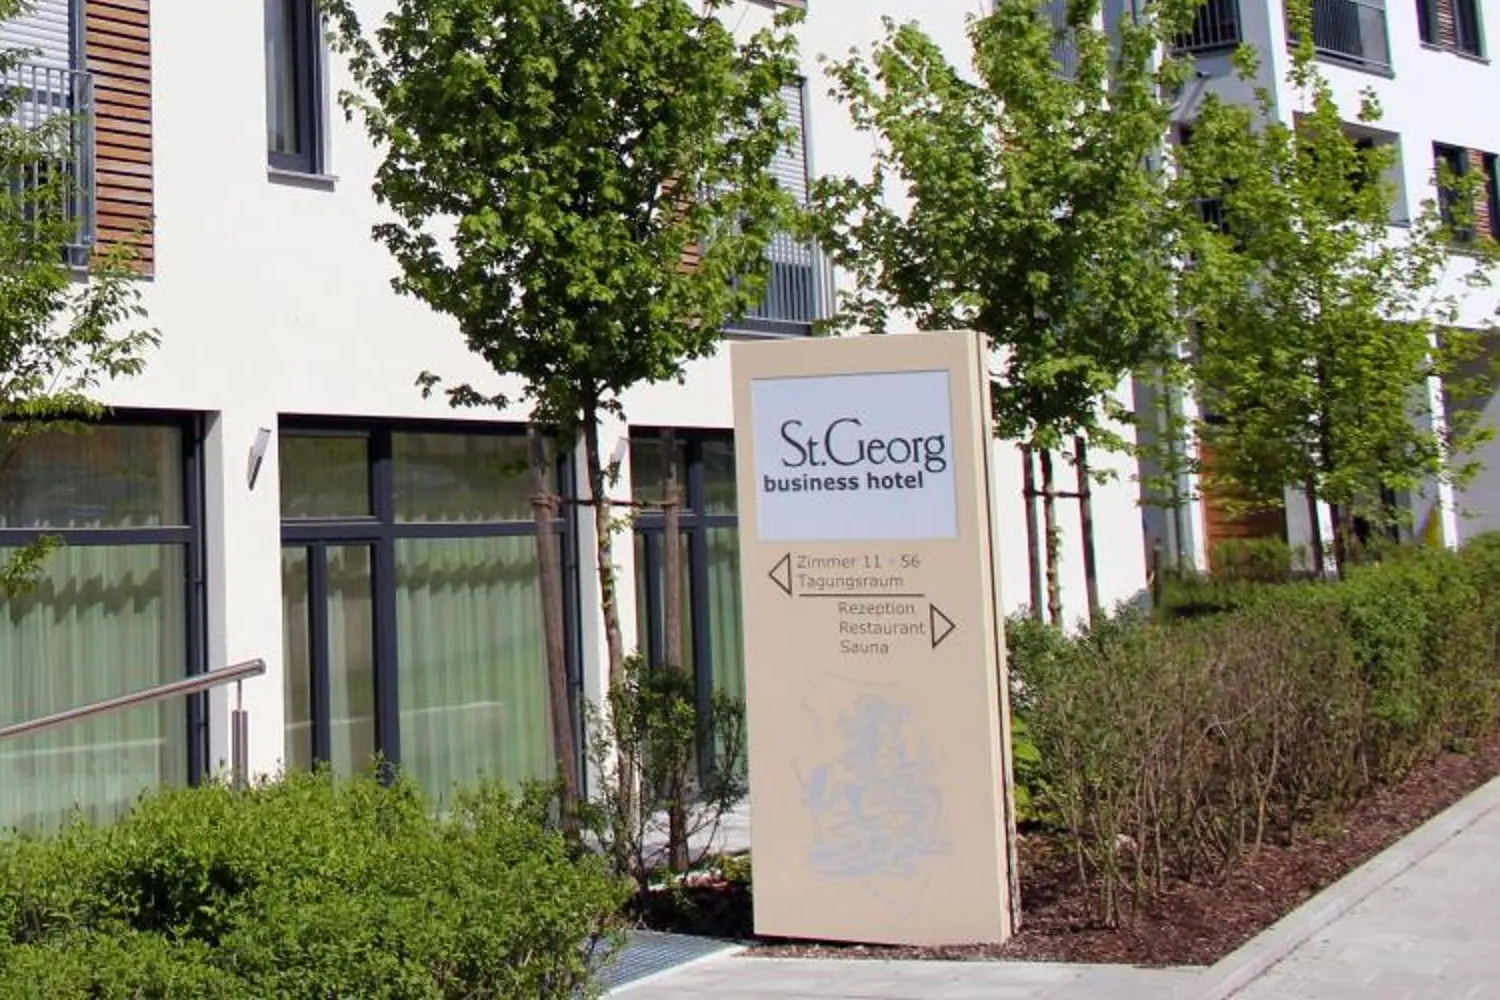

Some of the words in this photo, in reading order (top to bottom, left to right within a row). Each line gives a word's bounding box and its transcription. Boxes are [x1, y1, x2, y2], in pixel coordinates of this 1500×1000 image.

[780, 418, 947, 473] St.Georg
[763, 474, 860, 493] business
[866, 471, 924, 490] hotel
[797, 555, 856, 569] Zimmer
[864, 554, 881, 569] 11
[901, 554, 921, 568] 56
[798, 573, 904, 591] Tagungsraum
[838, 601, 915, 617] Rezeption
[839, 620, 927, 636] Restaurant
[840, 639, 889, 654] Sauna
